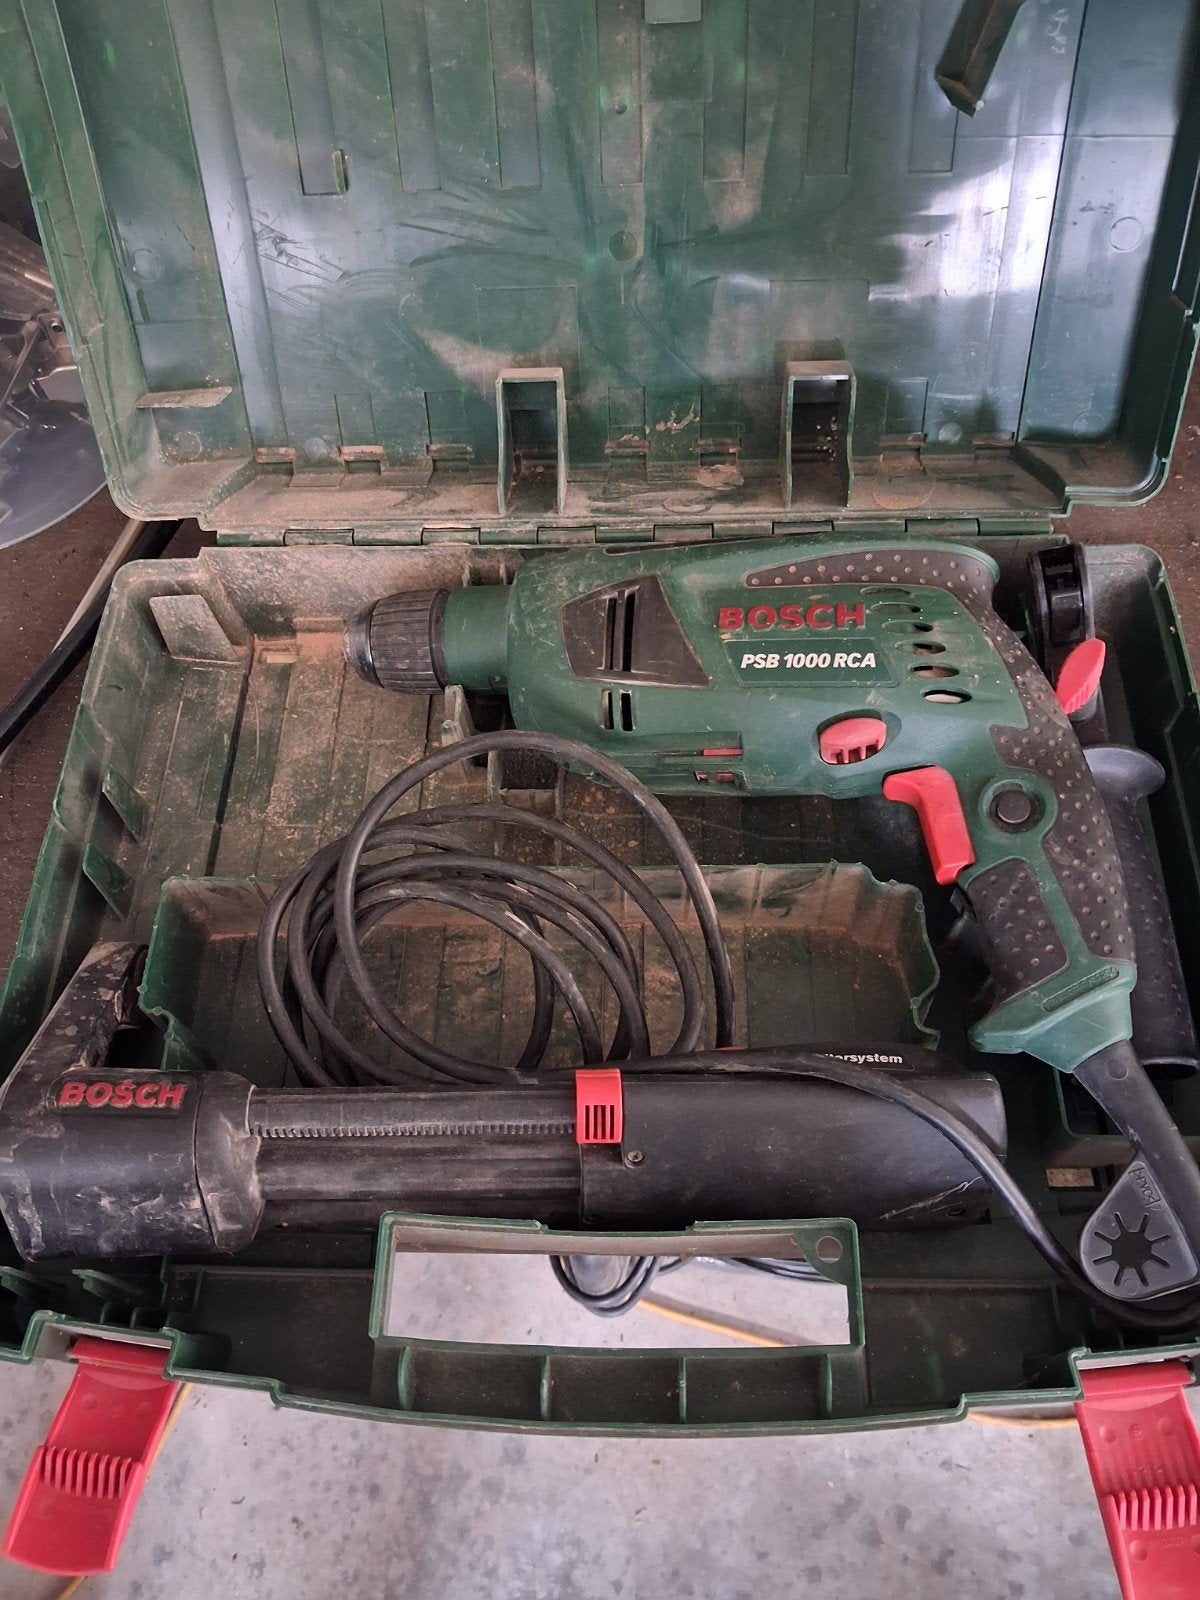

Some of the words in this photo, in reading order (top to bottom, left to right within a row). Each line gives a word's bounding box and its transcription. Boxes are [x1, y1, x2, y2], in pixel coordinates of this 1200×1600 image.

[718, 603, 866, 631] BOSCH
[741, 653, 781, 669] PSB
[784, 653, 831, 669] 1000
[833, 652, 877, 668] RCA
[58, 1080, 186, 1109] BOSCH
